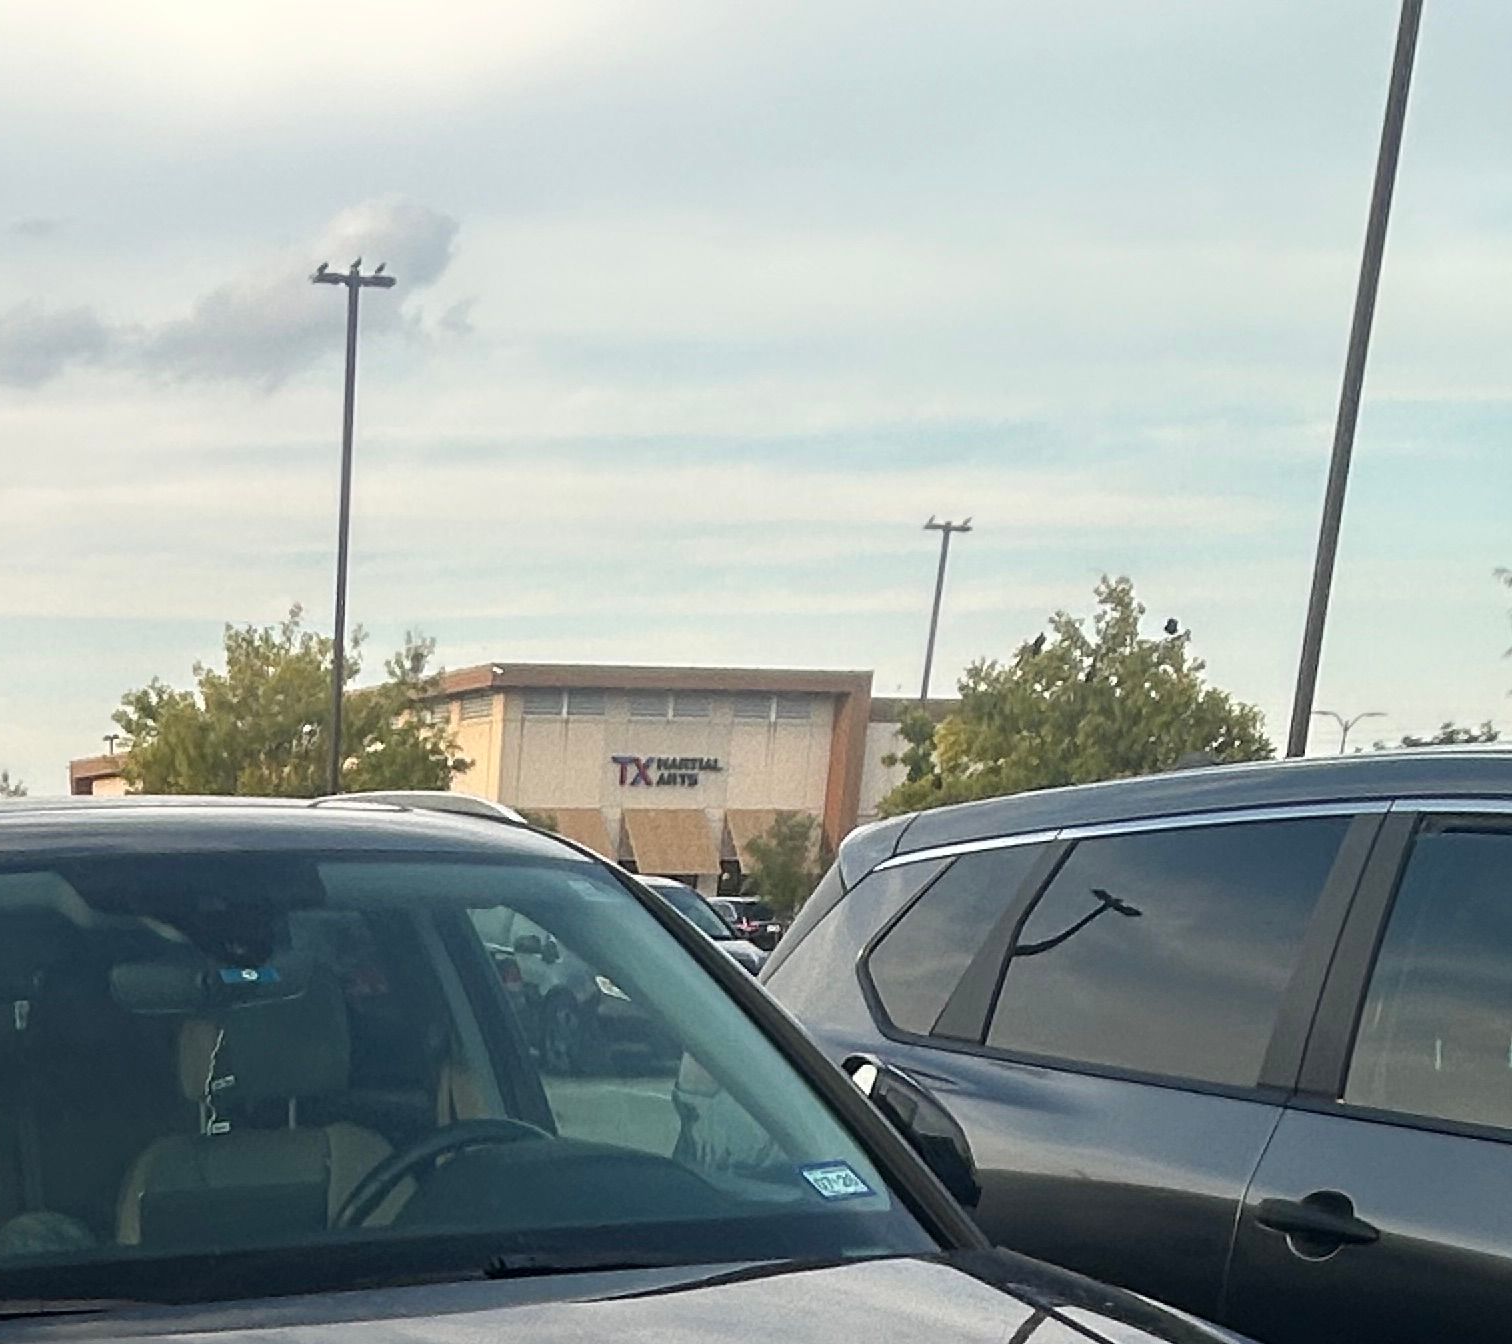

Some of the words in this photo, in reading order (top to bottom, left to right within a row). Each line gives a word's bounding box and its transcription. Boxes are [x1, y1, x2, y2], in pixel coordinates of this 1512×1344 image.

[611, 756, 655, 787] TX
[656, 756, 723, 772] MARTIAL
[656, 772, 700, 787] ARTS
